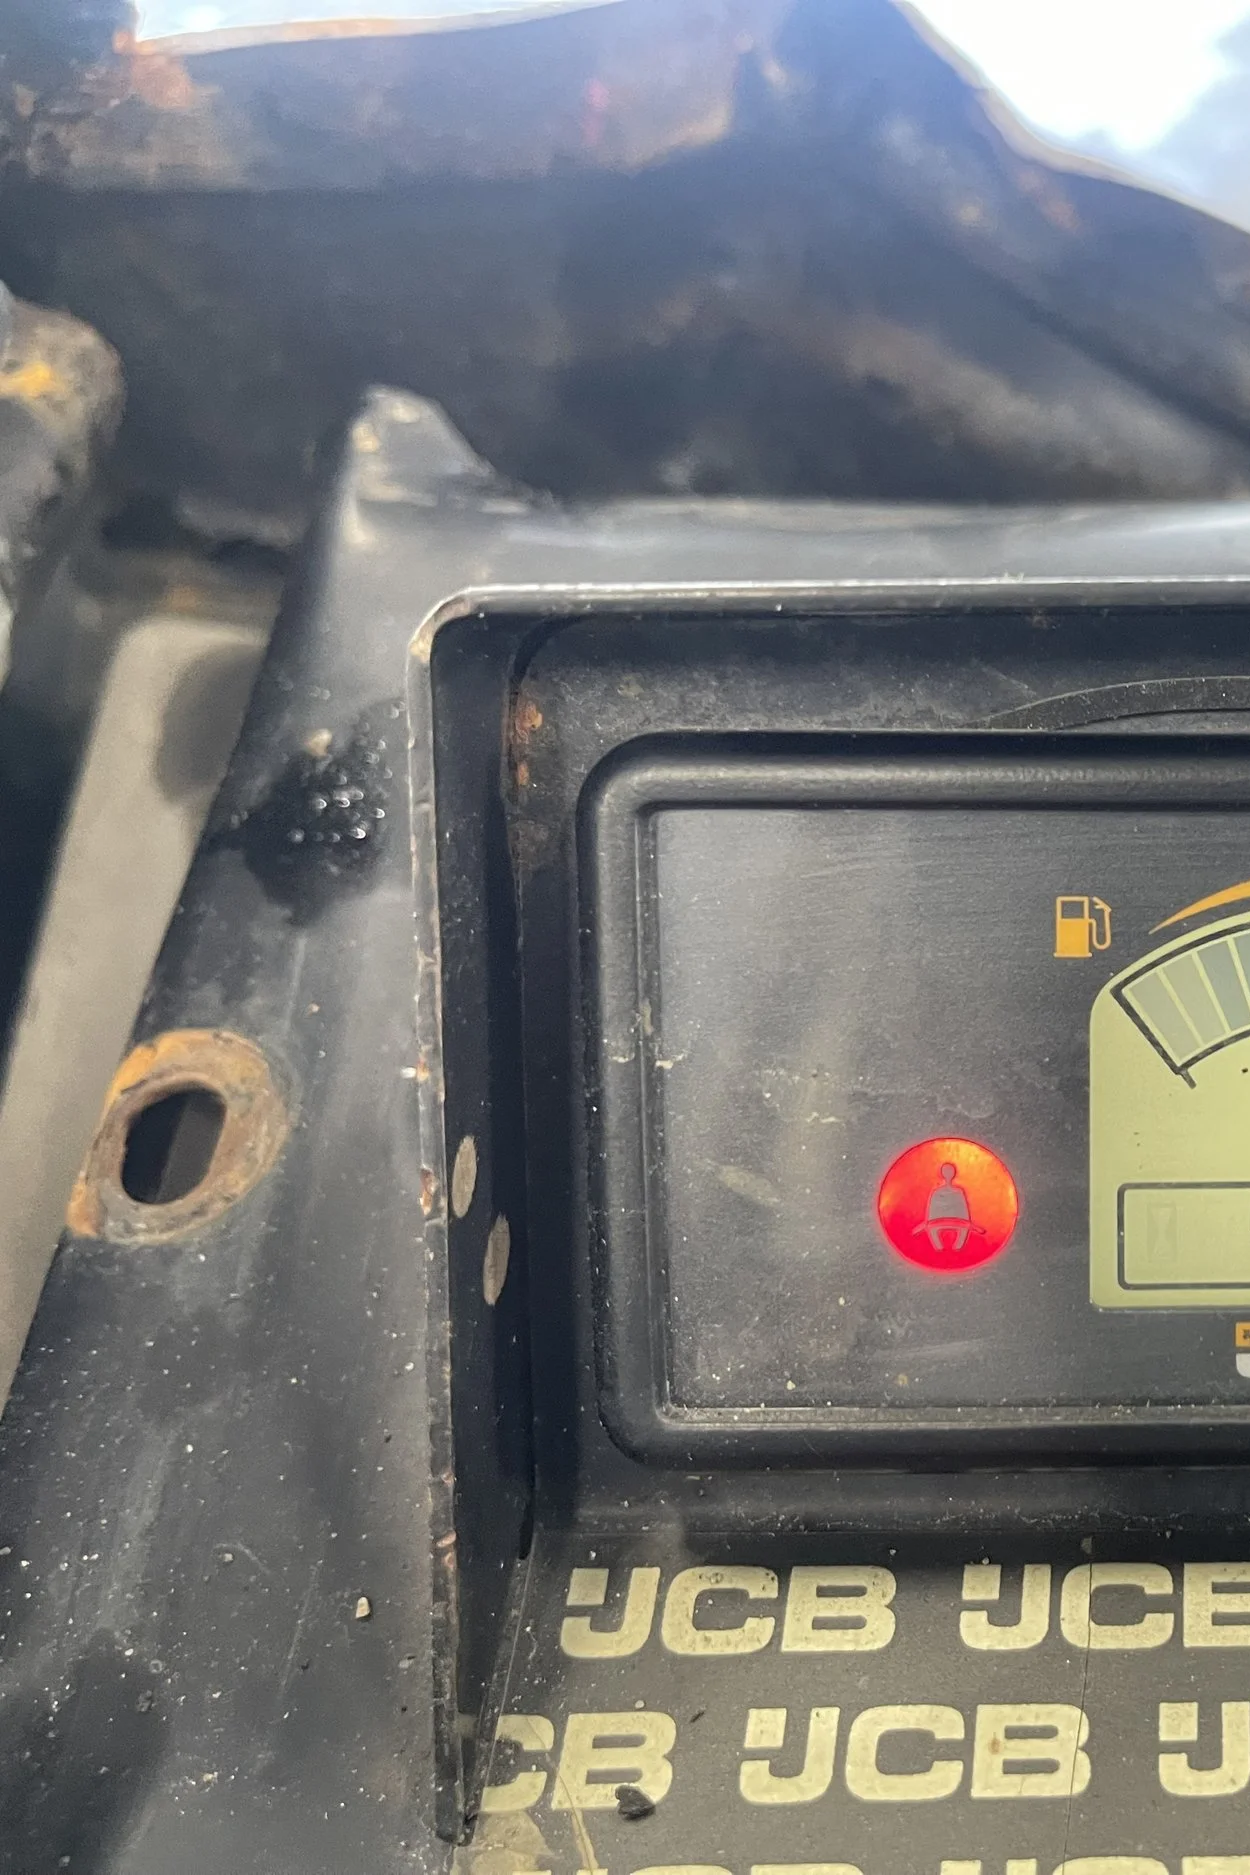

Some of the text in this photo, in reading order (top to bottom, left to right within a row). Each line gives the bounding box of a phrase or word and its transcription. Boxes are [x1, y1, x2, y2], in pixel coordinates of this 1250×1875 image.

[561, 1566, 896, 1656] JCB
[481, 1711, 676, 1811] CB
[740, 1704, 1091, 1802] JCB
